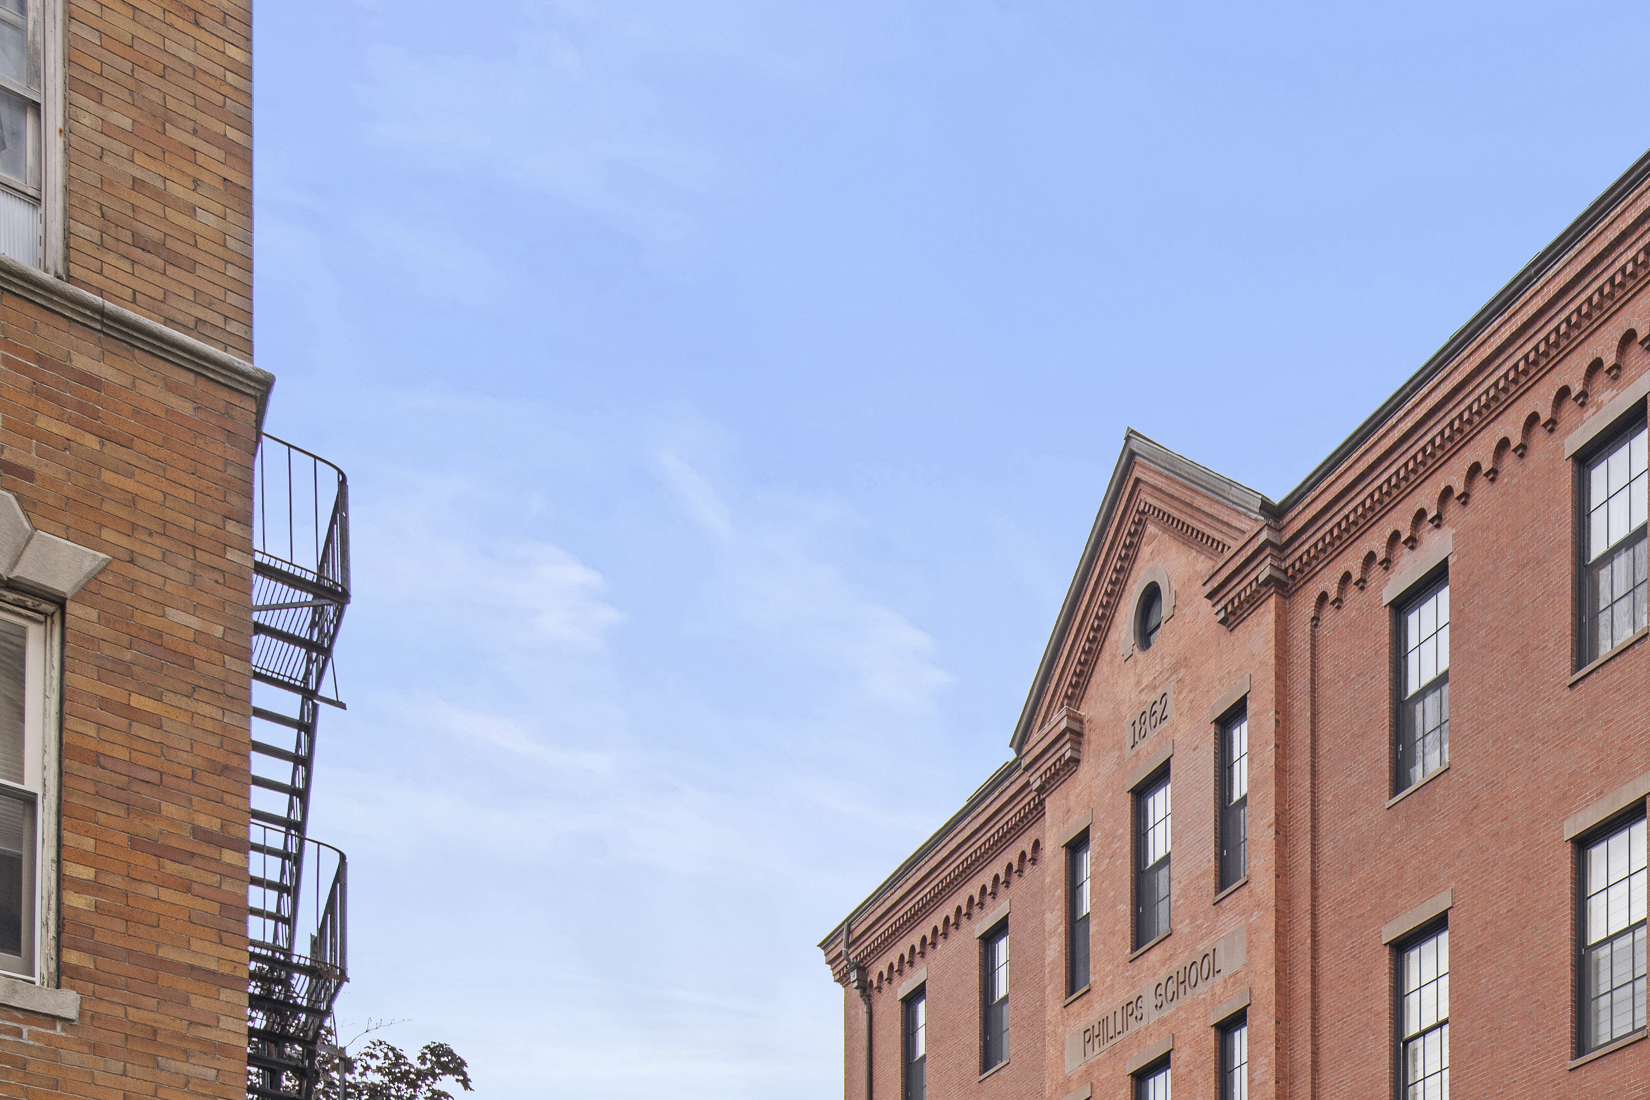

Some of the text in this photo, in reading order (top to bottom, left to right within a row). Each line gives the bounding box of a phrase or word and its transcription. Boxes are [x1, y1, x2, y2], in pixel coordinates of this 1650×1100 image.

[1129, 690, 1169, 751] 1862
[1082, 946, 1222, 1059] PHILLIPS SCHOOL
